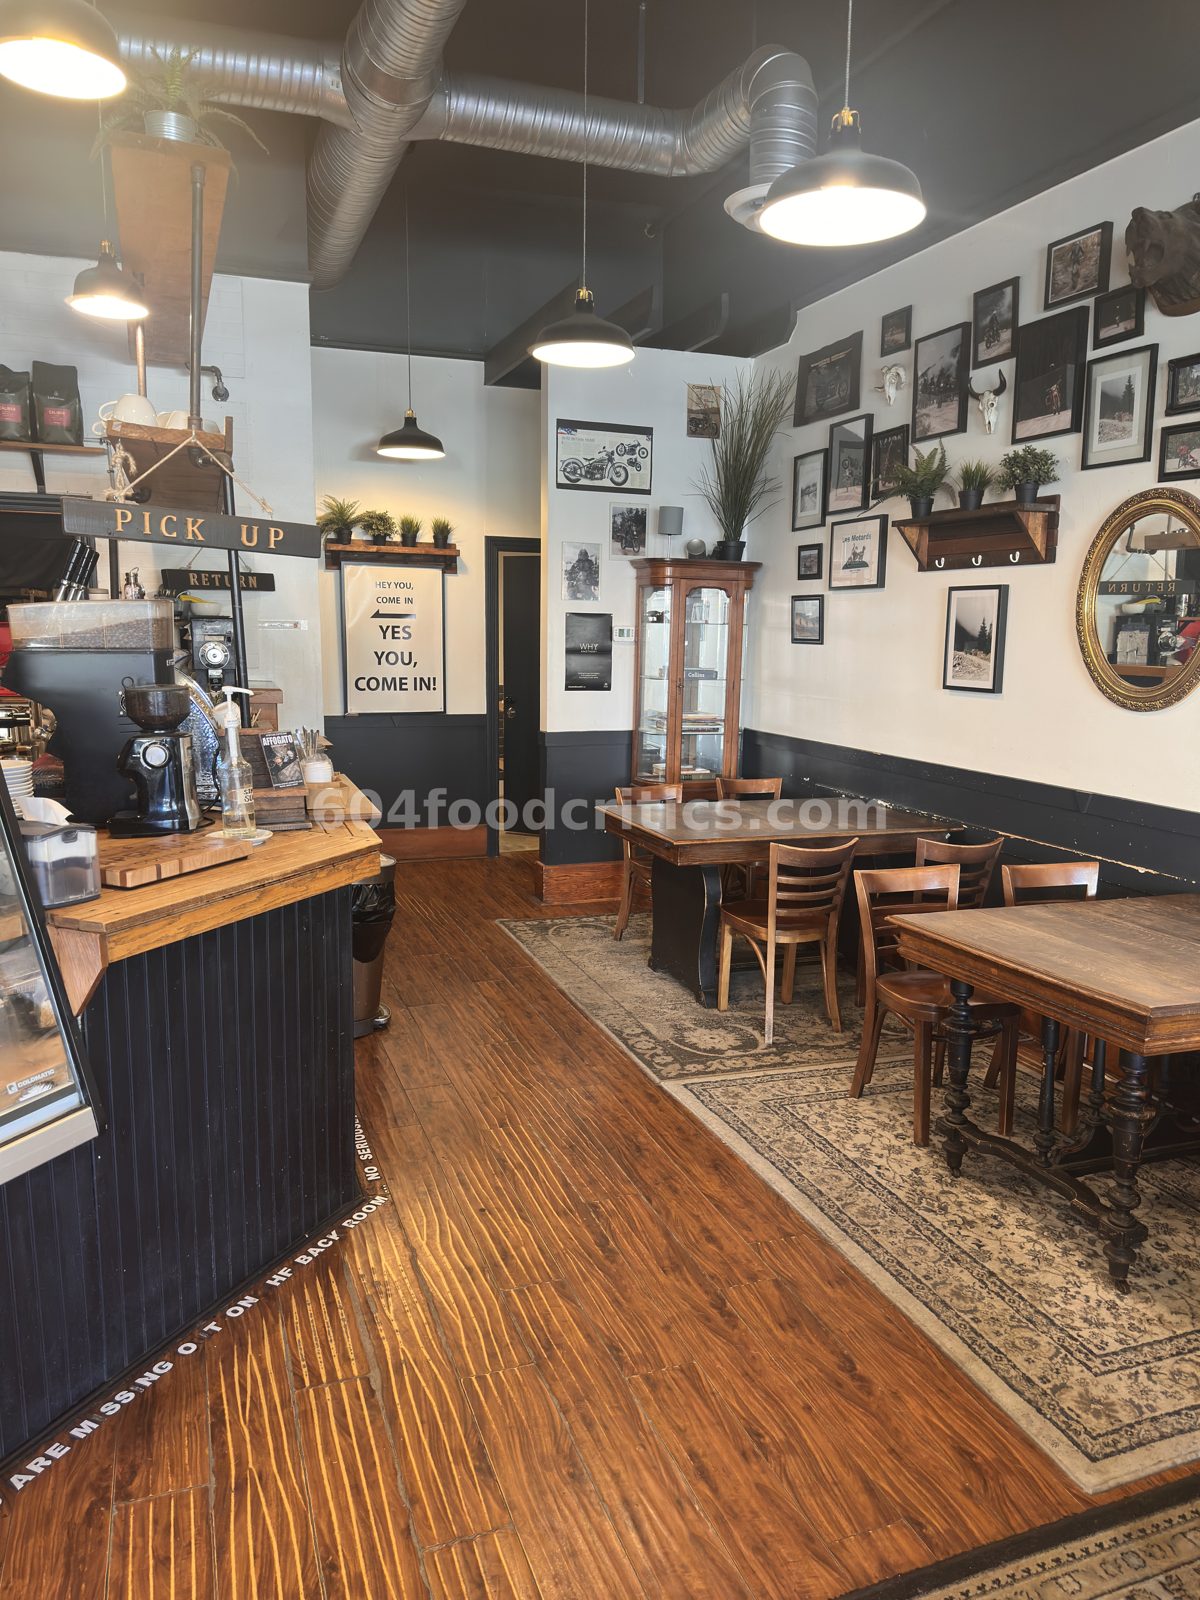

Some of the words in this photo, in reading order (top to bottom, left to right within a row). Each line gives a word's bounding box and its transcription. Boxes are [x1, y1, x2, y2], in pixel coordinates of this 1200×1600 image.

[114, 509, 205, 541] PICK
[241, 524, 284, 549] UP
[375, 581, 392, 589] HEY
[394, 582, 414, 590] YOU,
[376, 596, 401, 604] COME
[379, 625, 412, 640] YES
[374, 651, 418, 668] YOU,
[354, 676, 408, 691] COME
[413, 676, 437, 691] IN!
[262, 735, 293, 746] AFFOGATO
[364, 1166, 381, 1181] NO
[9, 1442, 71, 1490] ARE
[226, 1295, 260, 1318] ON
[294, 1229, 341, 1265] BACK
